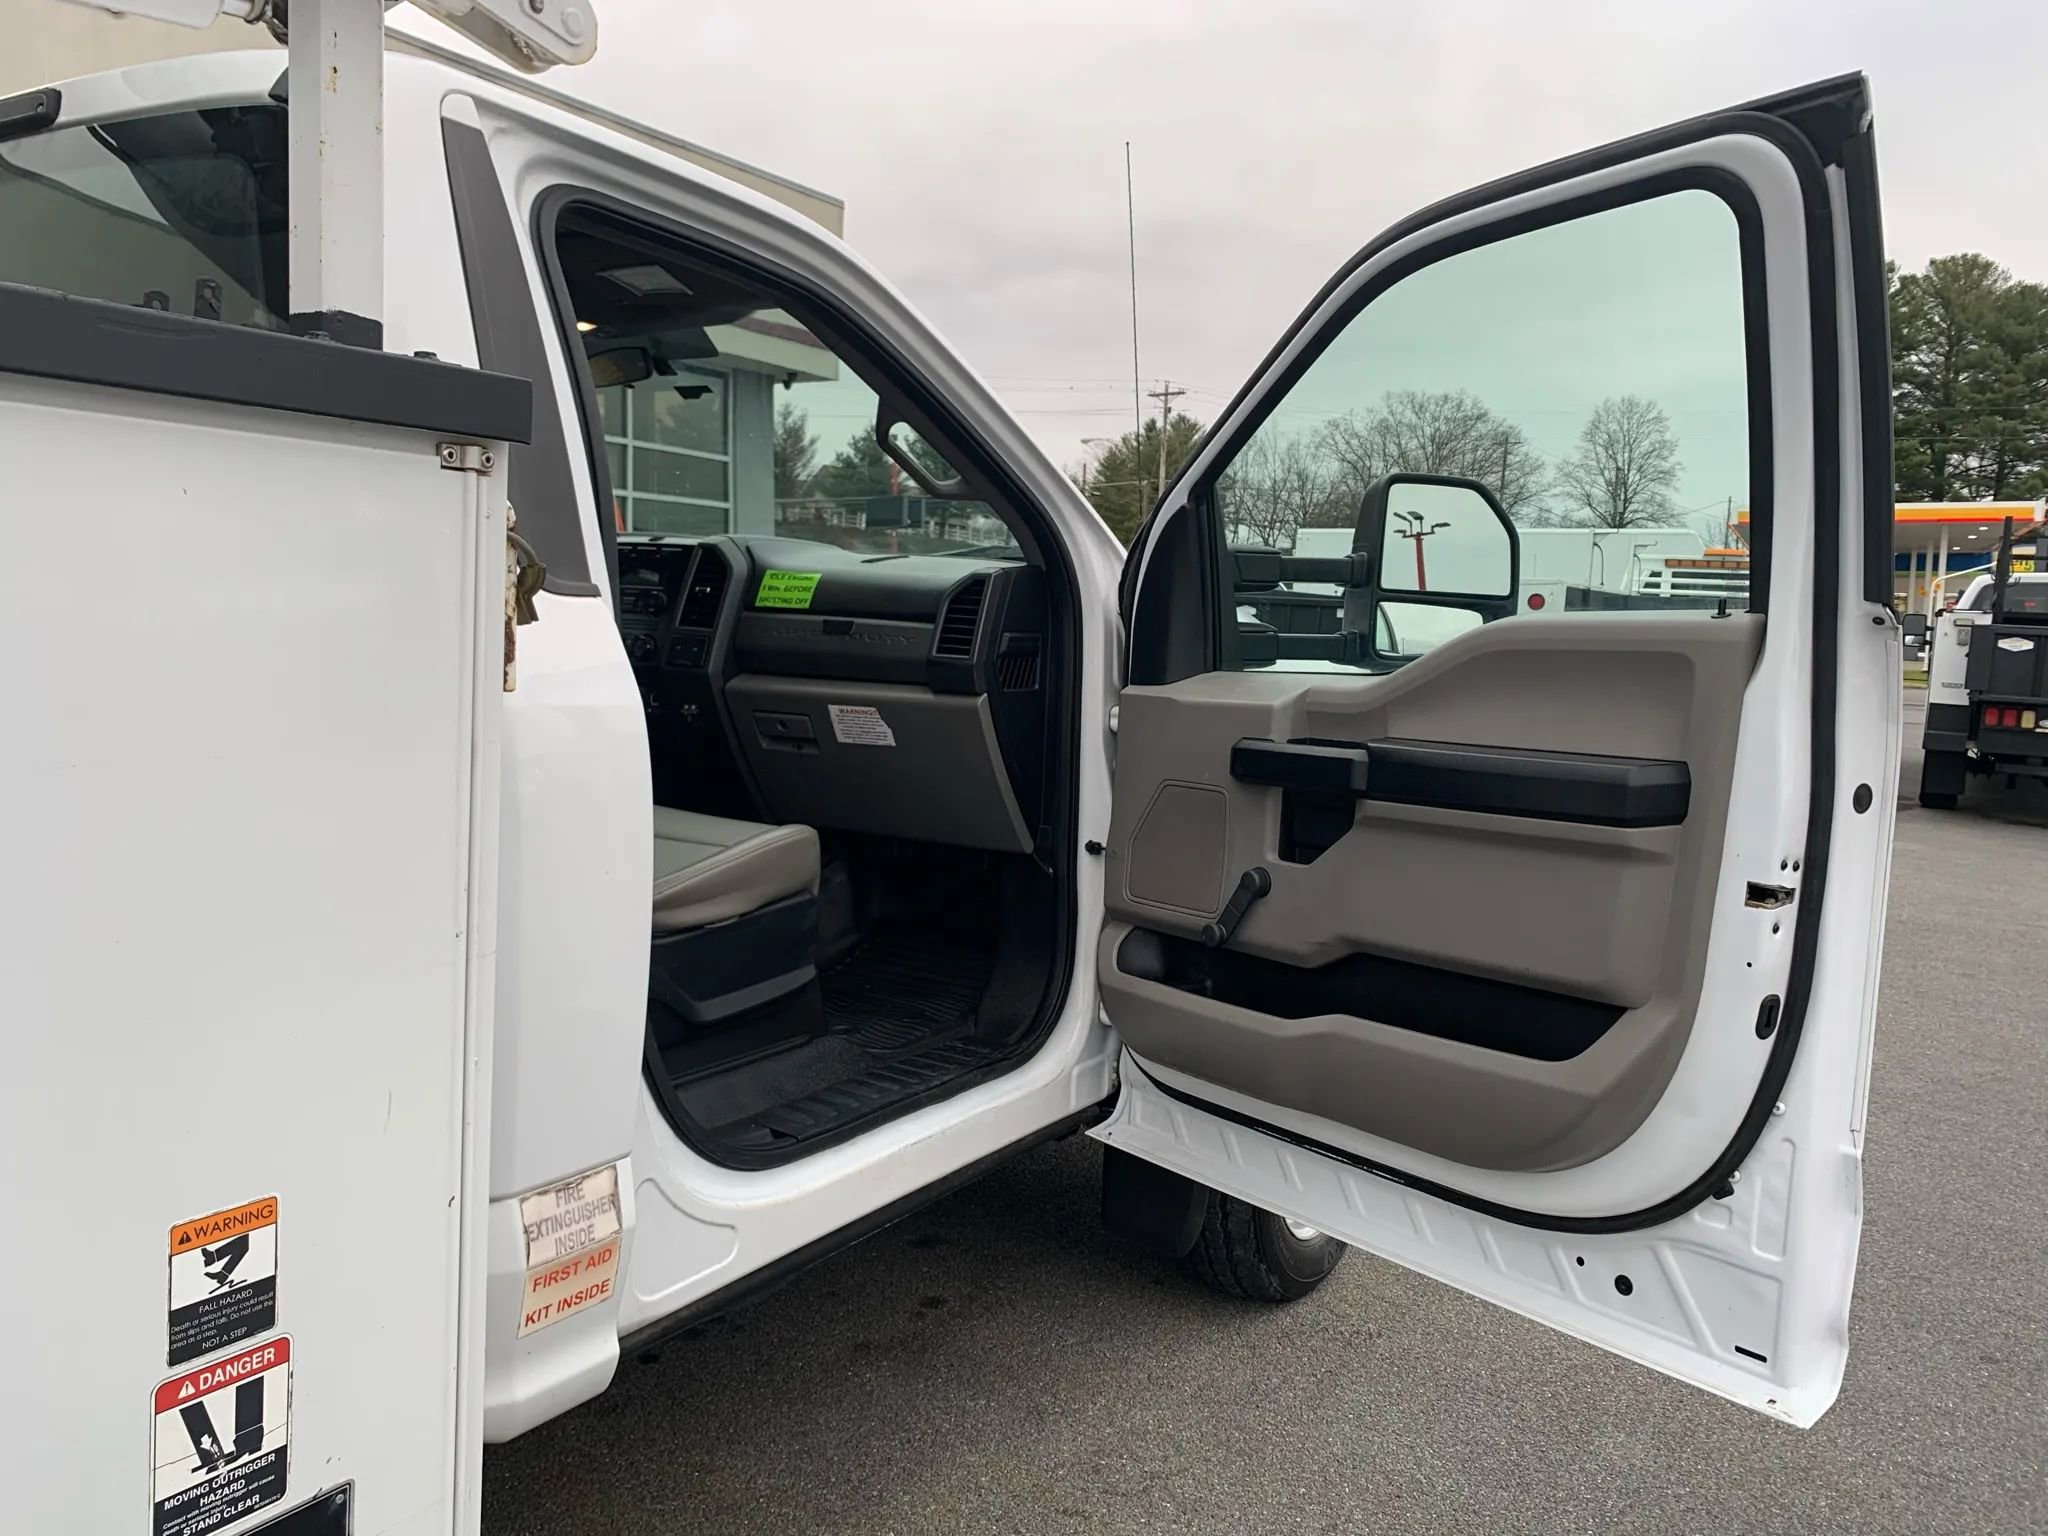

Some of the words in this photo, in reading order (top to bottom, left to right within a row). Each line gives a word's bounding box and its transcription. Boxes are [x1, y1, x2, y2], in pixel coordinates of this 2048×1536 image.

[555, 1183, 586, 1209] FIRE
[194, 1204, 274, 1240] WARNING
[526, 1193, 616, 1243] EXTINGUISHER
[554, 1224, 596, 1256] INSIDE
[533, 1260, 582, 1293] FIRST
[585, 1248, 612, 1271] AID
[170, 1322, 192, 1334] Death
[200, 1312, 222, 1323] serious
[222, 1305, 239, 1316] injury
[239, 1297, 257, 1309] could
[199, 1301, 218, 1314] FALL
[219, 1288, 253, 1306] HAZARD
[525, 1303, 553, 1328] KIT
[556, 1278, 611, 1314] INSIDE
[188, 1326, 200, 1337] slips
[201, 1321, 215, 1330] and
[230, 1312, 240, 1321] Do
[240, 1308, 251, 1317] not
[202, 1337, 220, 1349] NOT
[221, 1334, 228, 1342] A
[230, 1326, 248, 1339] STEP
[170, 1340, 187, 1350] area
[199, 1347, 275, 1391] DANGER
[164, 1483, 210, 1511] MOVING
[212, 1453, 276, 1489] OUTRIGGER
[200, 1479, 246, 1507] HAZARD
[162, 1515, 186, 1530] Contact
[186, 1509, 200, 1519] with
[183, 1512, 221, 1536] STAND
[223, 1494, 260, 1518] CLEAR
